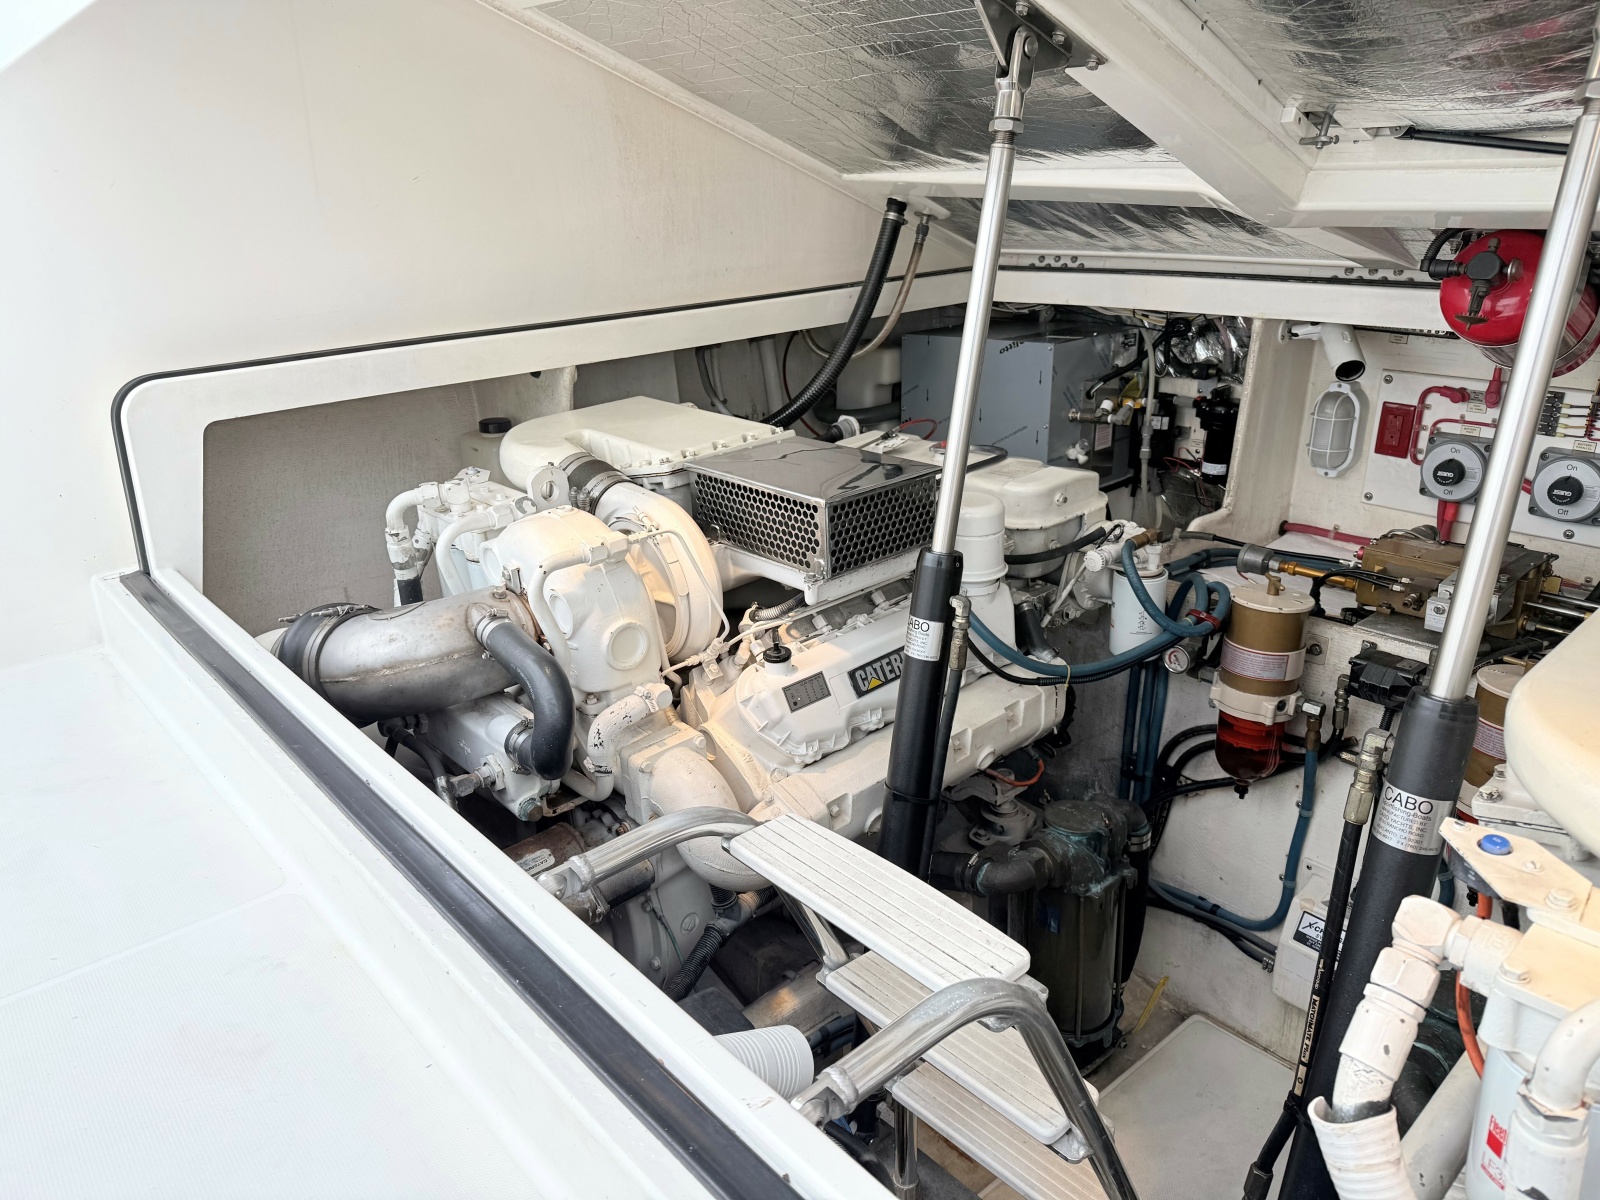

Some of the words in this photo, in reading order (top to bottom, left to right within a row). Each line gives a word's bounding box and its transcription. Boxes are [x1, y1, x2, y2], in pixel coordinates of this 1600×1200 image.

[1443, 488, 1454, 496] Off
[1557, 508, 1569, 516] Off
[855, 650, 904, 692] CATER
[1384, 786, 1434, 815] CABO
[1304, 998, 1319, 1042] MATCHMATE
